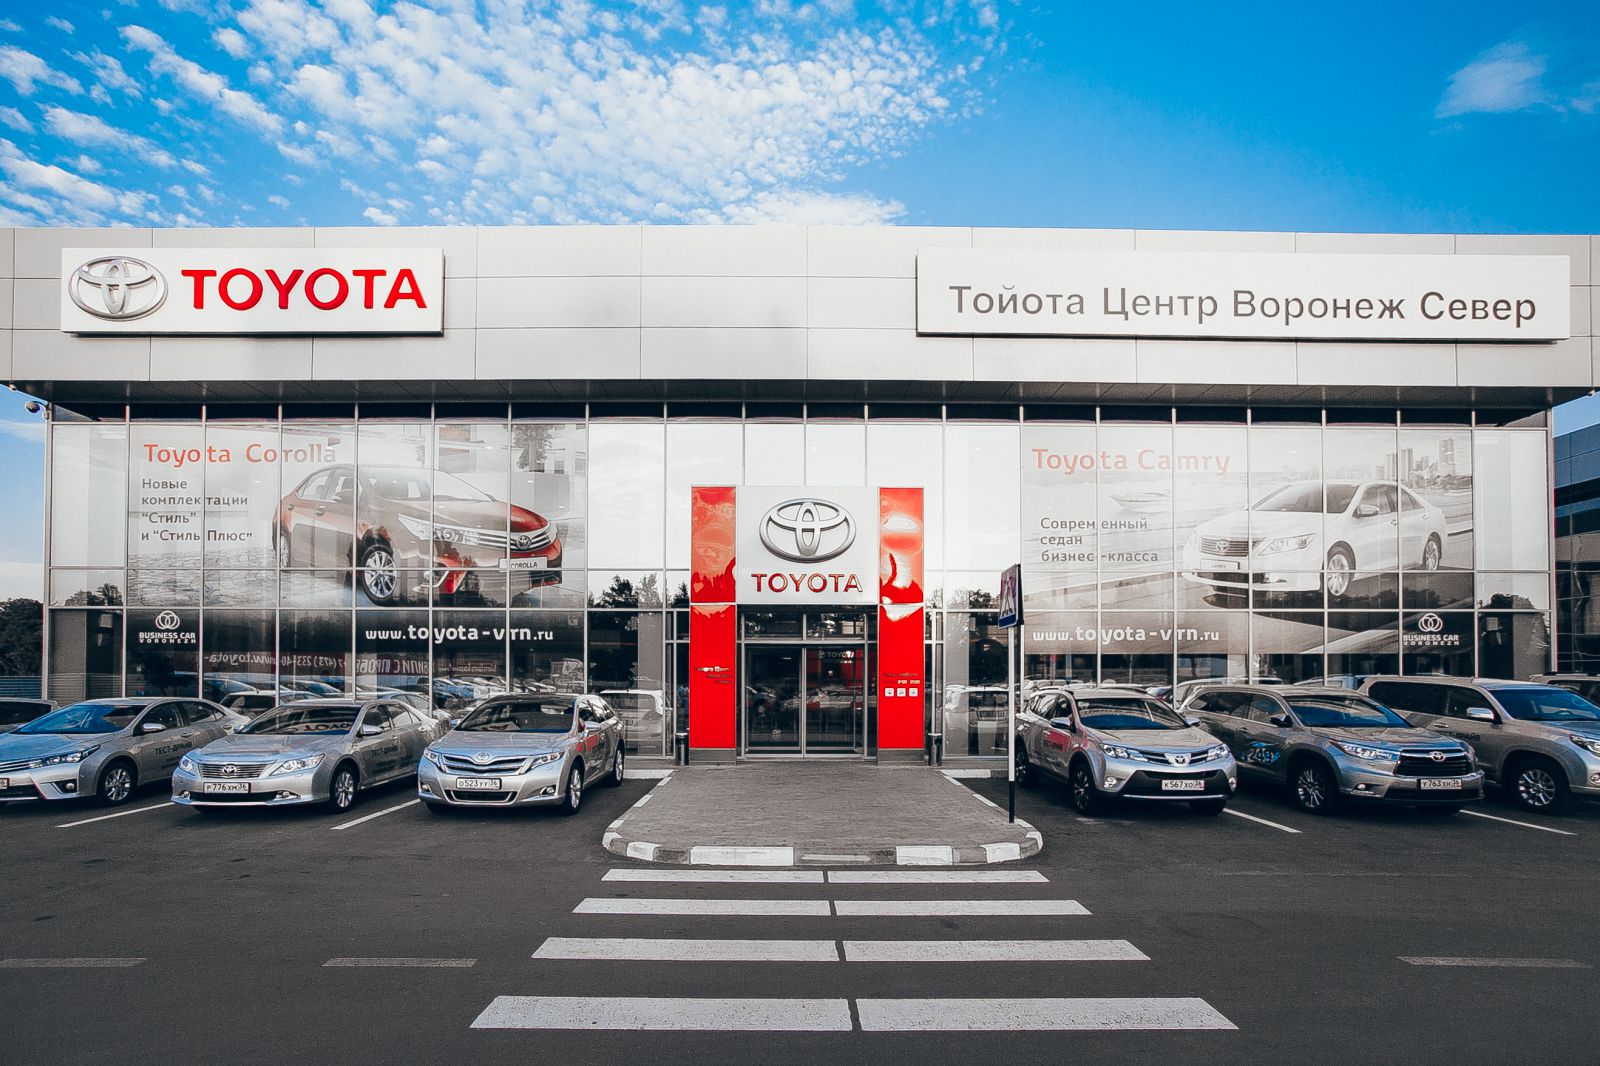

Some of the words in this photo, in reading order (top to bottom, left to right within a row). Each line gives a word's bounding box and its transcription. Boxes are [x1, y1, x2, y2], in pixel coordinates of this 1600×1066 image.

[181, 267, 428, 310] TOYOTA
[949, 284, 1085, 315] Тойота
[1103, 287, 1218, 325] Центр
[1233, 289, 1406, 326] Воронеж
[1420, 291, 1536, 328] Север
[143, 443, 231, 468] Toyota
[245, 443, 337, 463] Corolla
[1031, 448, 1128, 475] Toyota
[1137, 449, 1231, 476] Camry
[141, 478, 188, 489] Новые
[141, 496, 248, 507] комплектации
[1040, 517, 1148, 532] Современный
[141, 532, 149, 541] и
[1040, 535, 1083, 546] седан
[1041, 550, 1159, 562] бизнес-класса
[751, 572, 863, 593] TOYOTA
[365, 625, 554, 644] www.toyota-vrn.ru
[1032, 626, 1220, 645] www.toyota-vrn.ru
